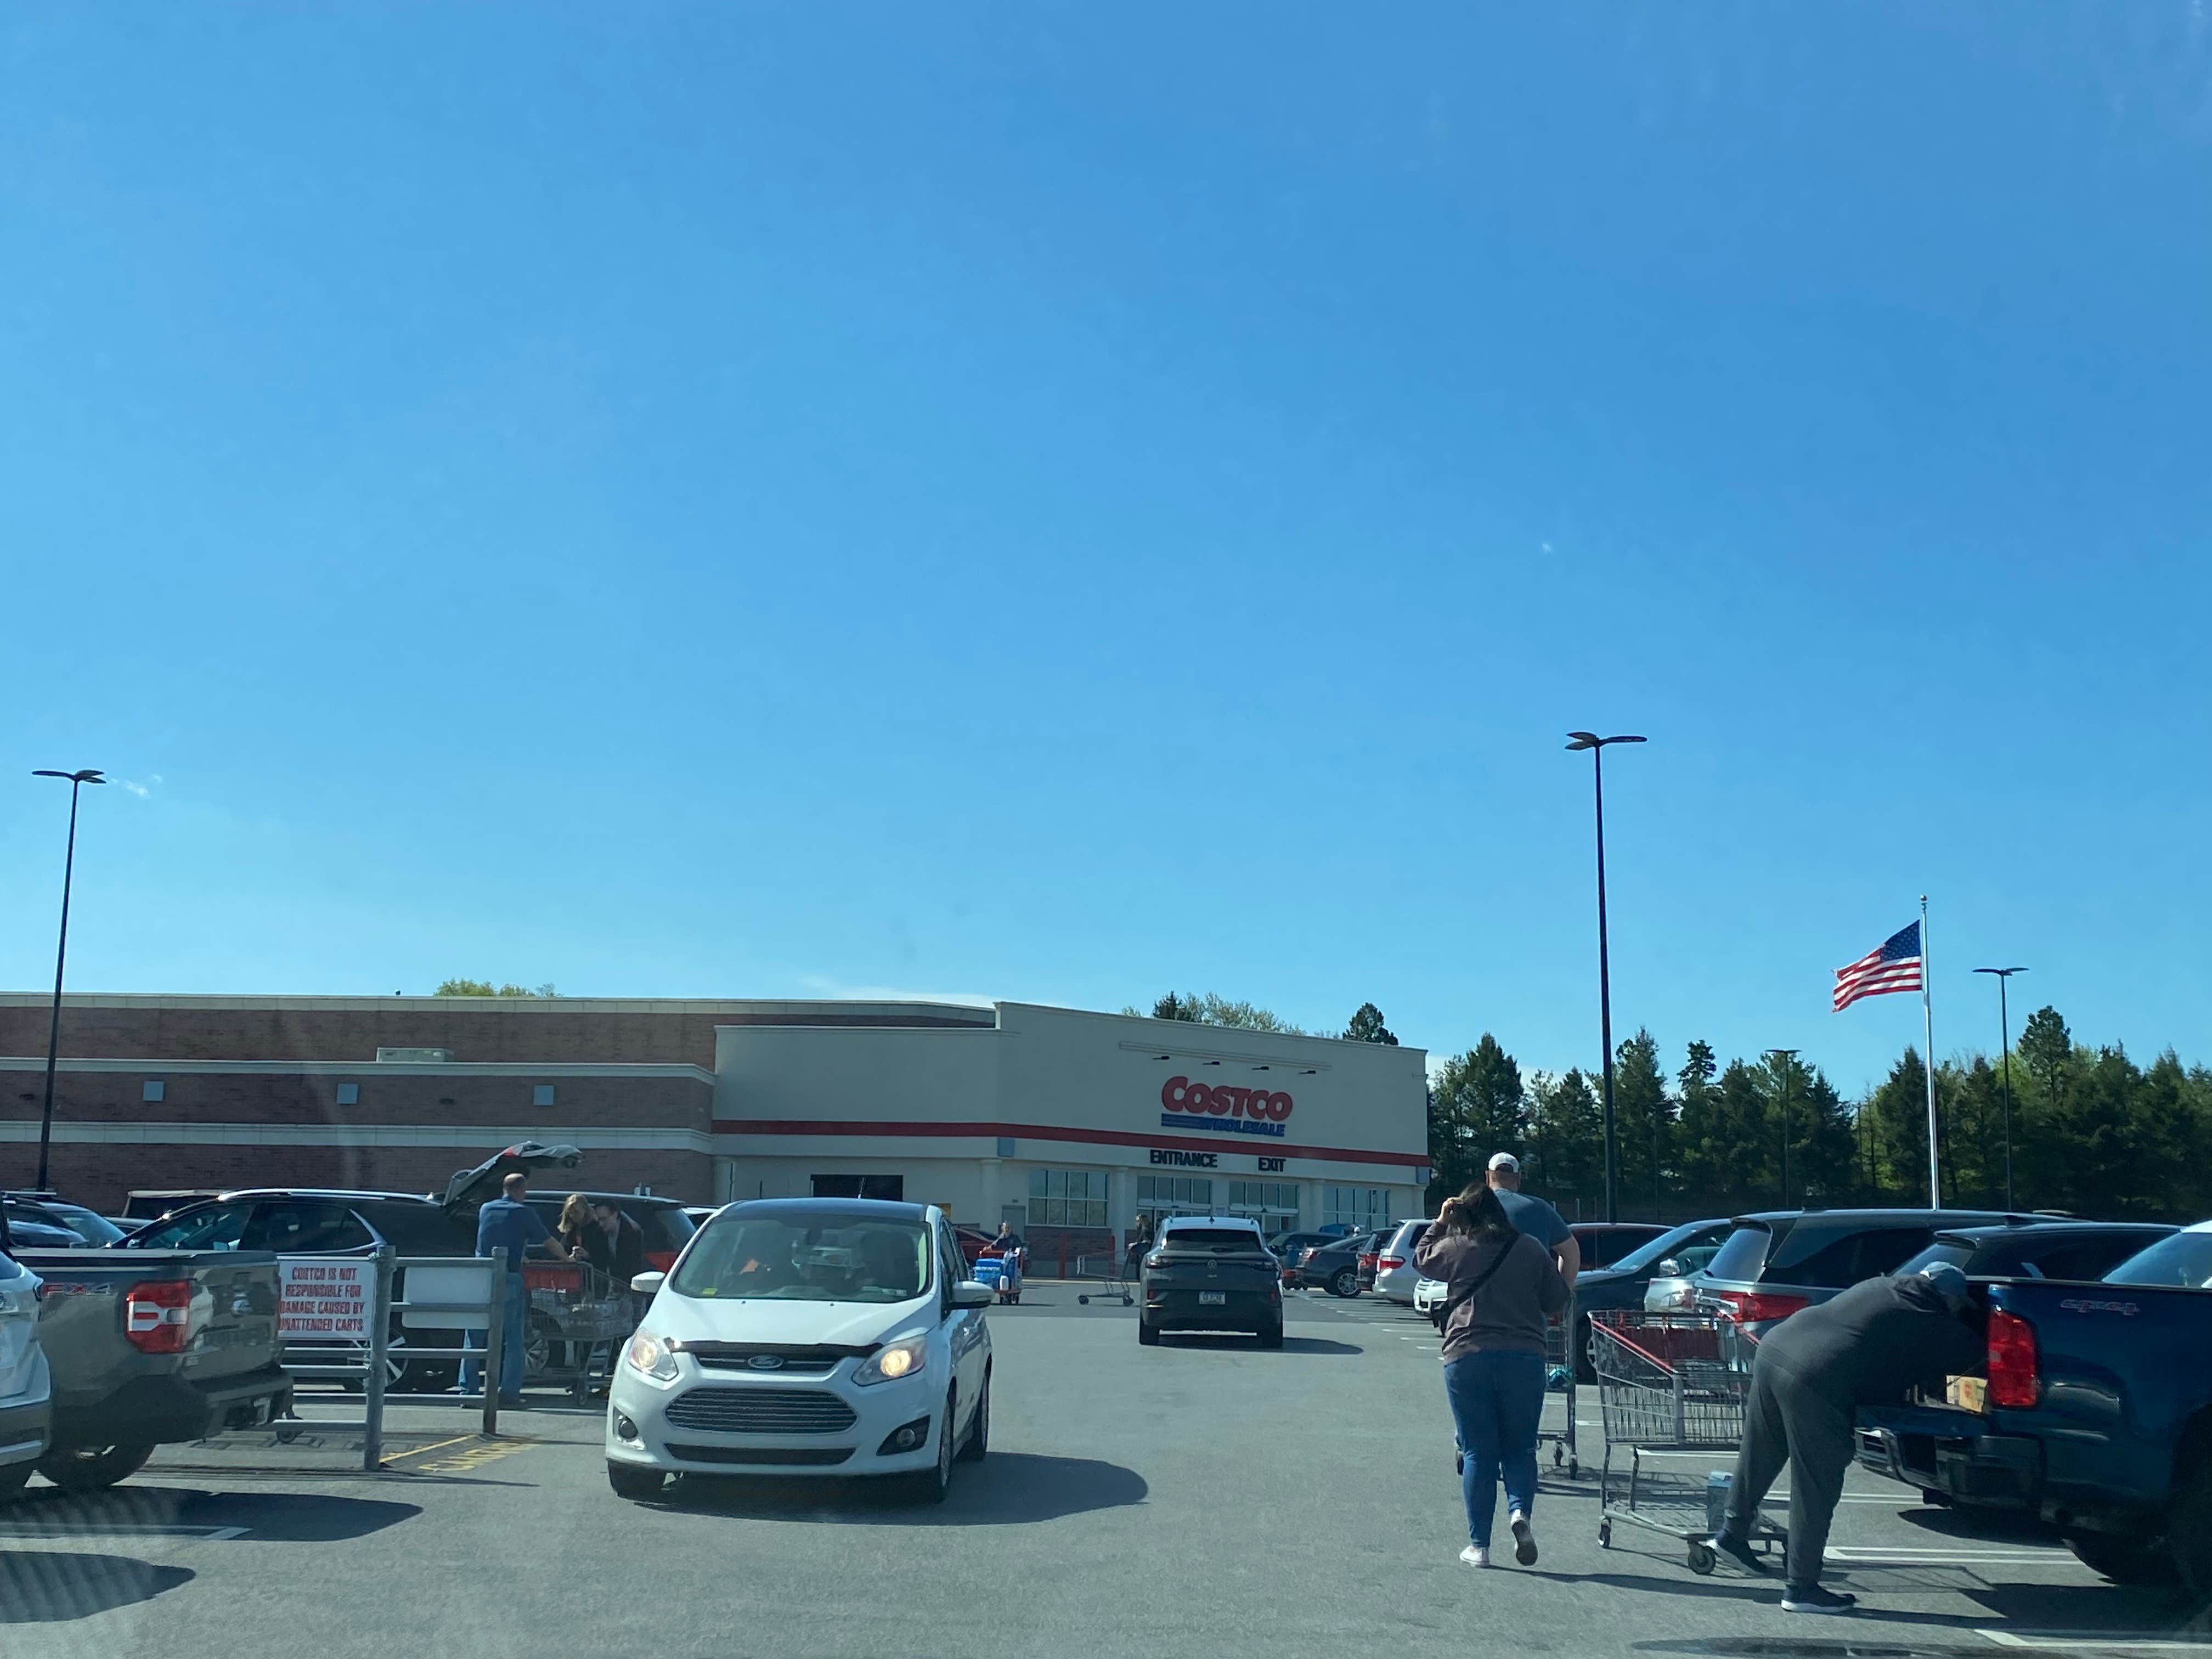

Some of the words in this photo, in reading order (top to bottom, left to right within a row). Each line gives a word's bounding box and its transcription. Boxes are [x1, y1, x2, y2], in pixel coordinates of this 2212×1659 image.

[1161, 1076, 1293, 1121] COSTCO
[1201, 1117, 1285, 1137] WHOLESALE
[1150, 1149, 1218, 1168] ENTRANCE
[1258, 1157, 1286, 1172] EXIT
[292, 1267, 326, 1280] COSTCO
[328, 1268, 336, 1280] IS
[339, 1268, 357, 1280] NOT
[42, 1283, 119, 1298] FX4
[285, 1284, 343, 1297] RESPONSIBLE
[345, 1285, 362, 1297] FOR
[318, 1302, 350, 1314] CAUSED
[353, 1302, 365, 1314] BY
[336, 1319, 364, 1331] CARTS
